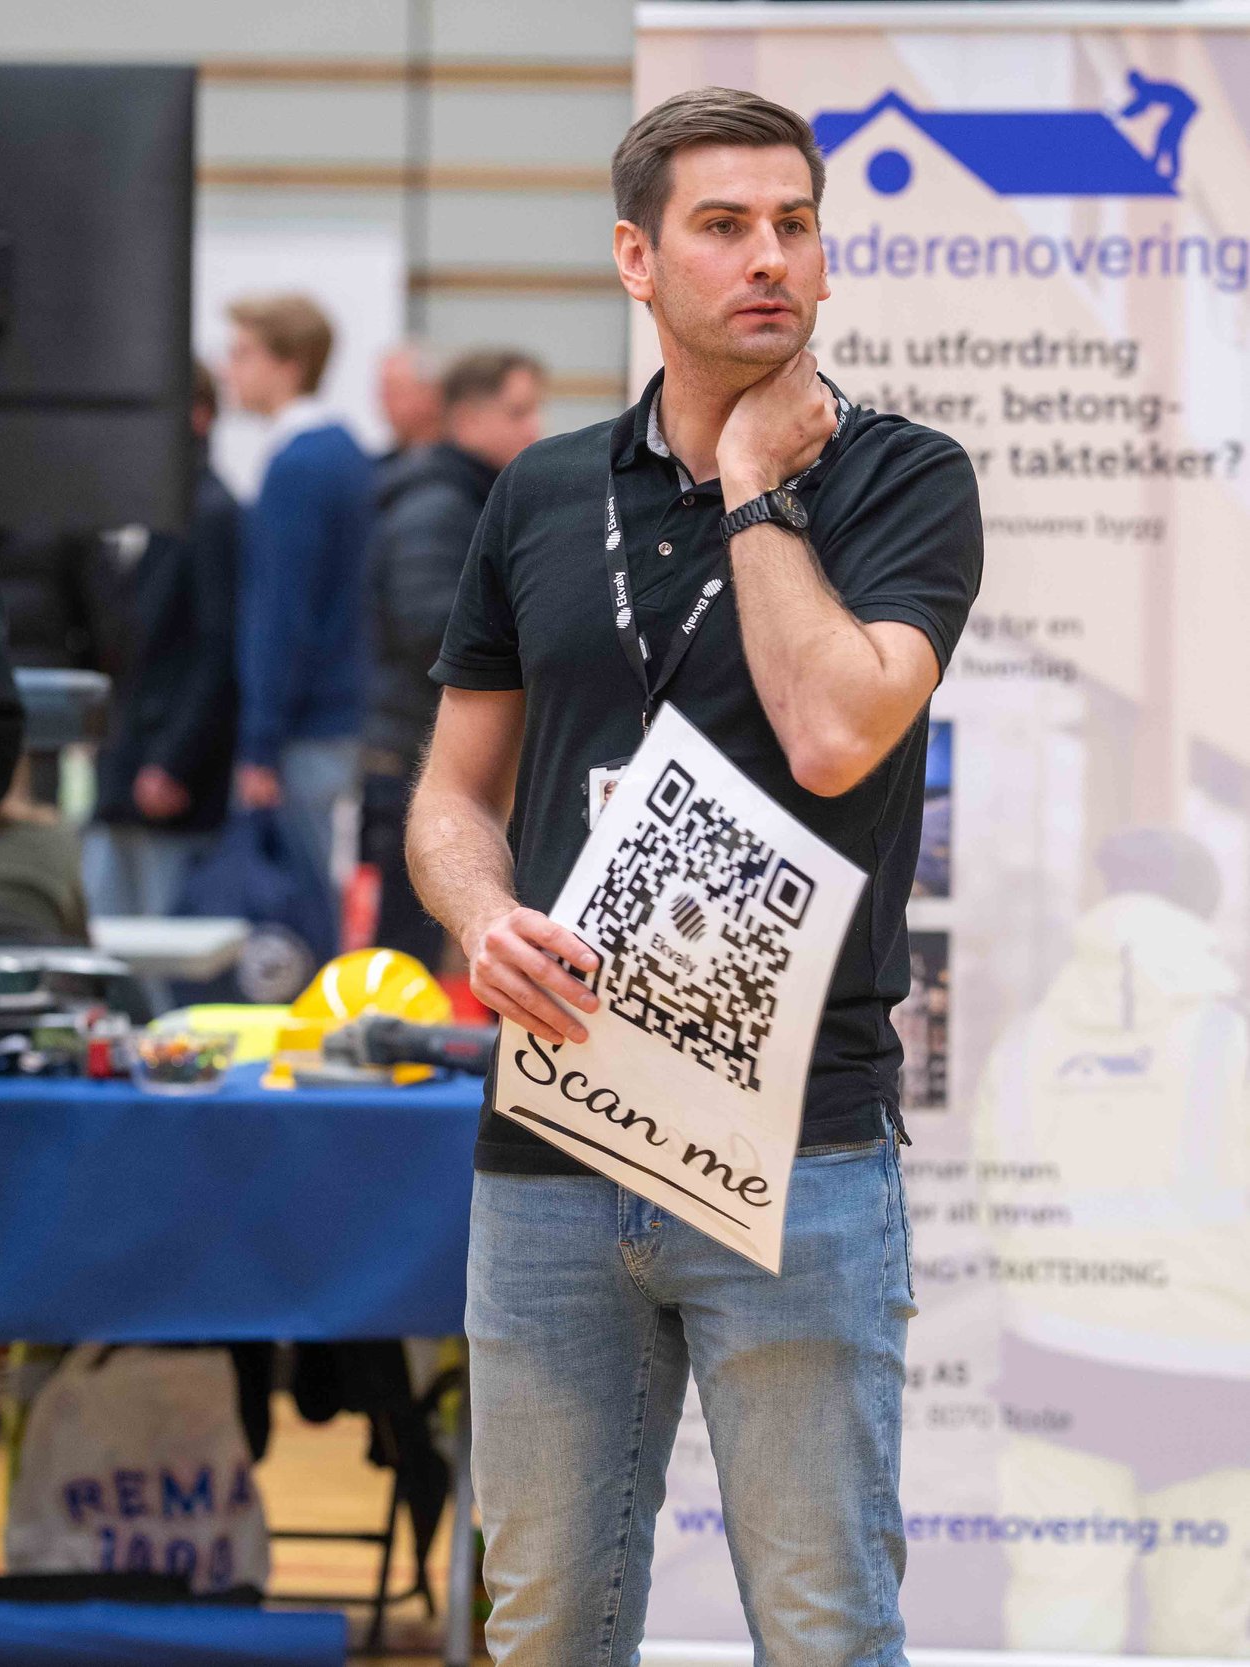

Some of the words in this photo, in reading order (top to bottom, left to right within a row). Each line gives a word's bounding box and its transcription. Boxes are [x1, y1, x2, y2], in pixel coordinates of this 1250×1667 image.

[832, 330, 891, 367] du
[906, 329, 1139, 378] utfordring
[1002, 386, 1181, 432] betong-
[1009, 440, 1243, 478] taktekker?
[613, 571, 627, 607] Ekvaly
[681, 597, 709, 635] Ekvaly
[514, 1031, 668, 1147] Scan
[682, 1142, 772, 1208] me
